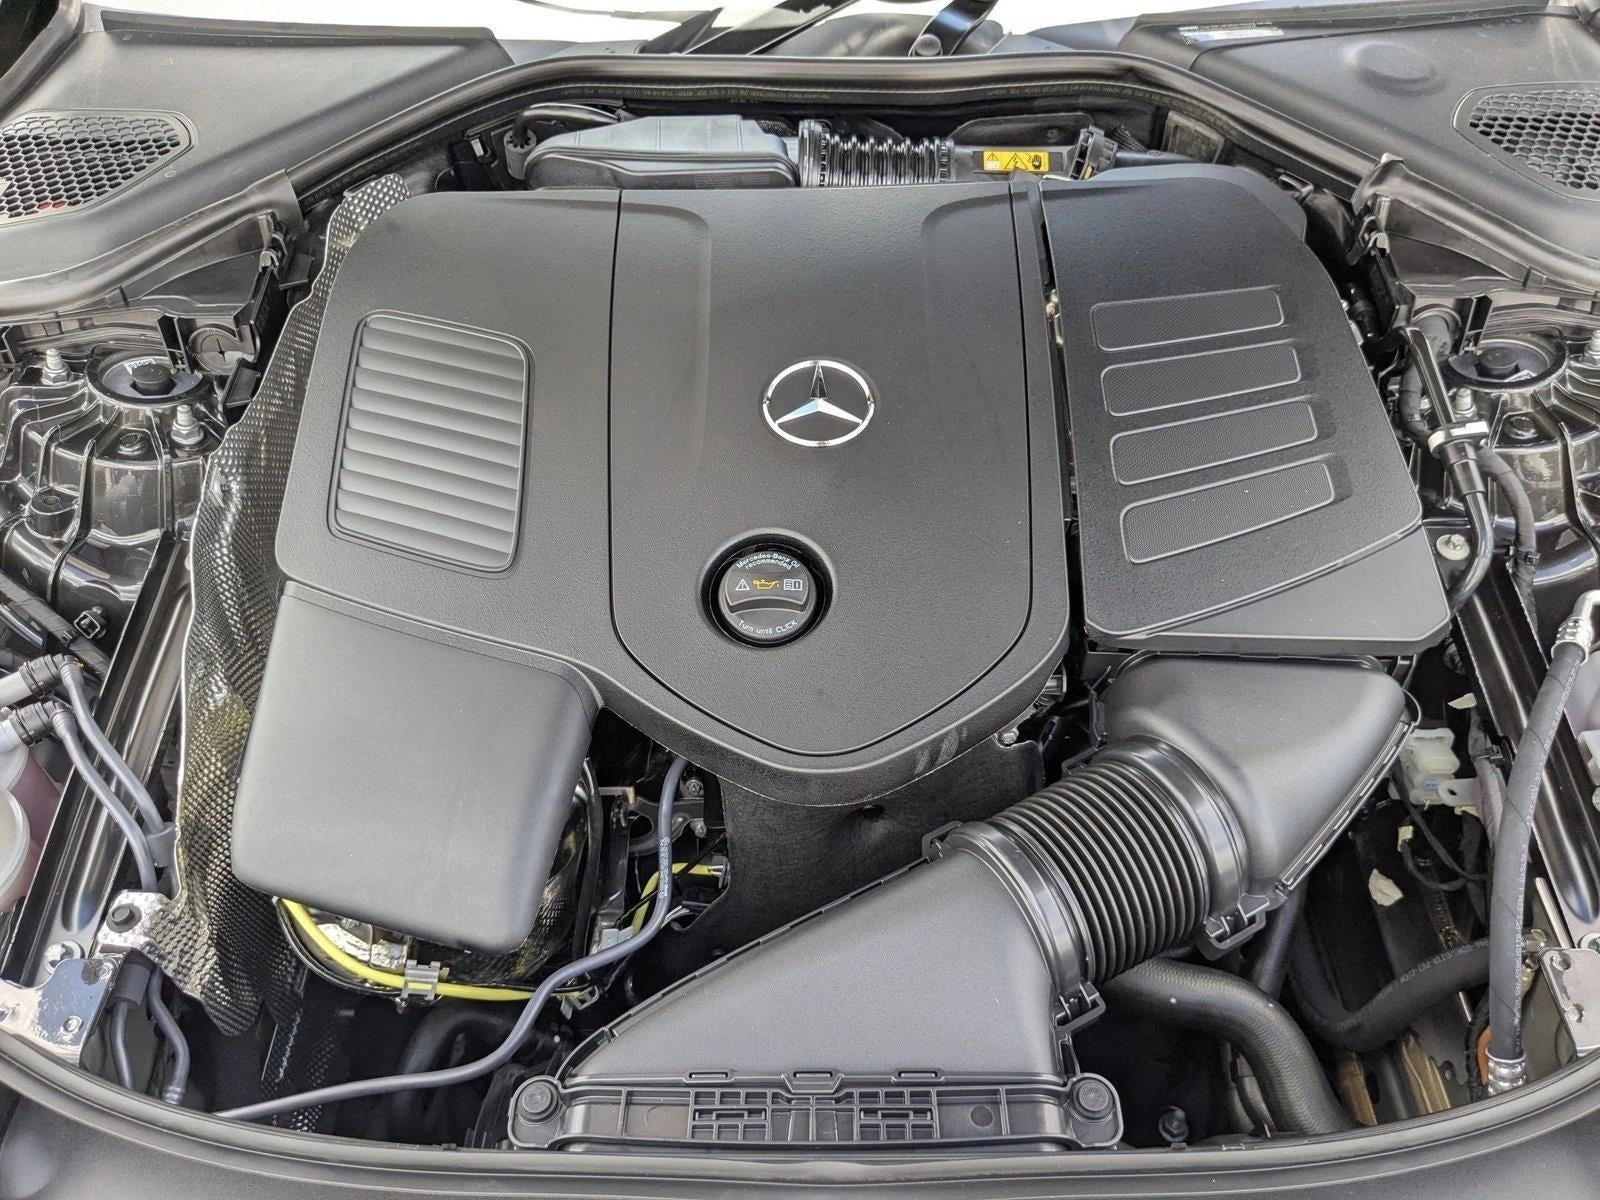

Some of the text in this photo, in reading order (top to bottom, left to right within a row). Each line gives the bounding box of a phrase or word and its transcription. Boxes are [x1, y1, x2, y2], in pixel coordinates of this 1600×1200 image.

[736, 553, 790, 569] Mercedes-Benz
[745, 558, 792, 569] recommended
[738, 620, 754, 632] Turn
[775, 620, 798, 633] CLICK
